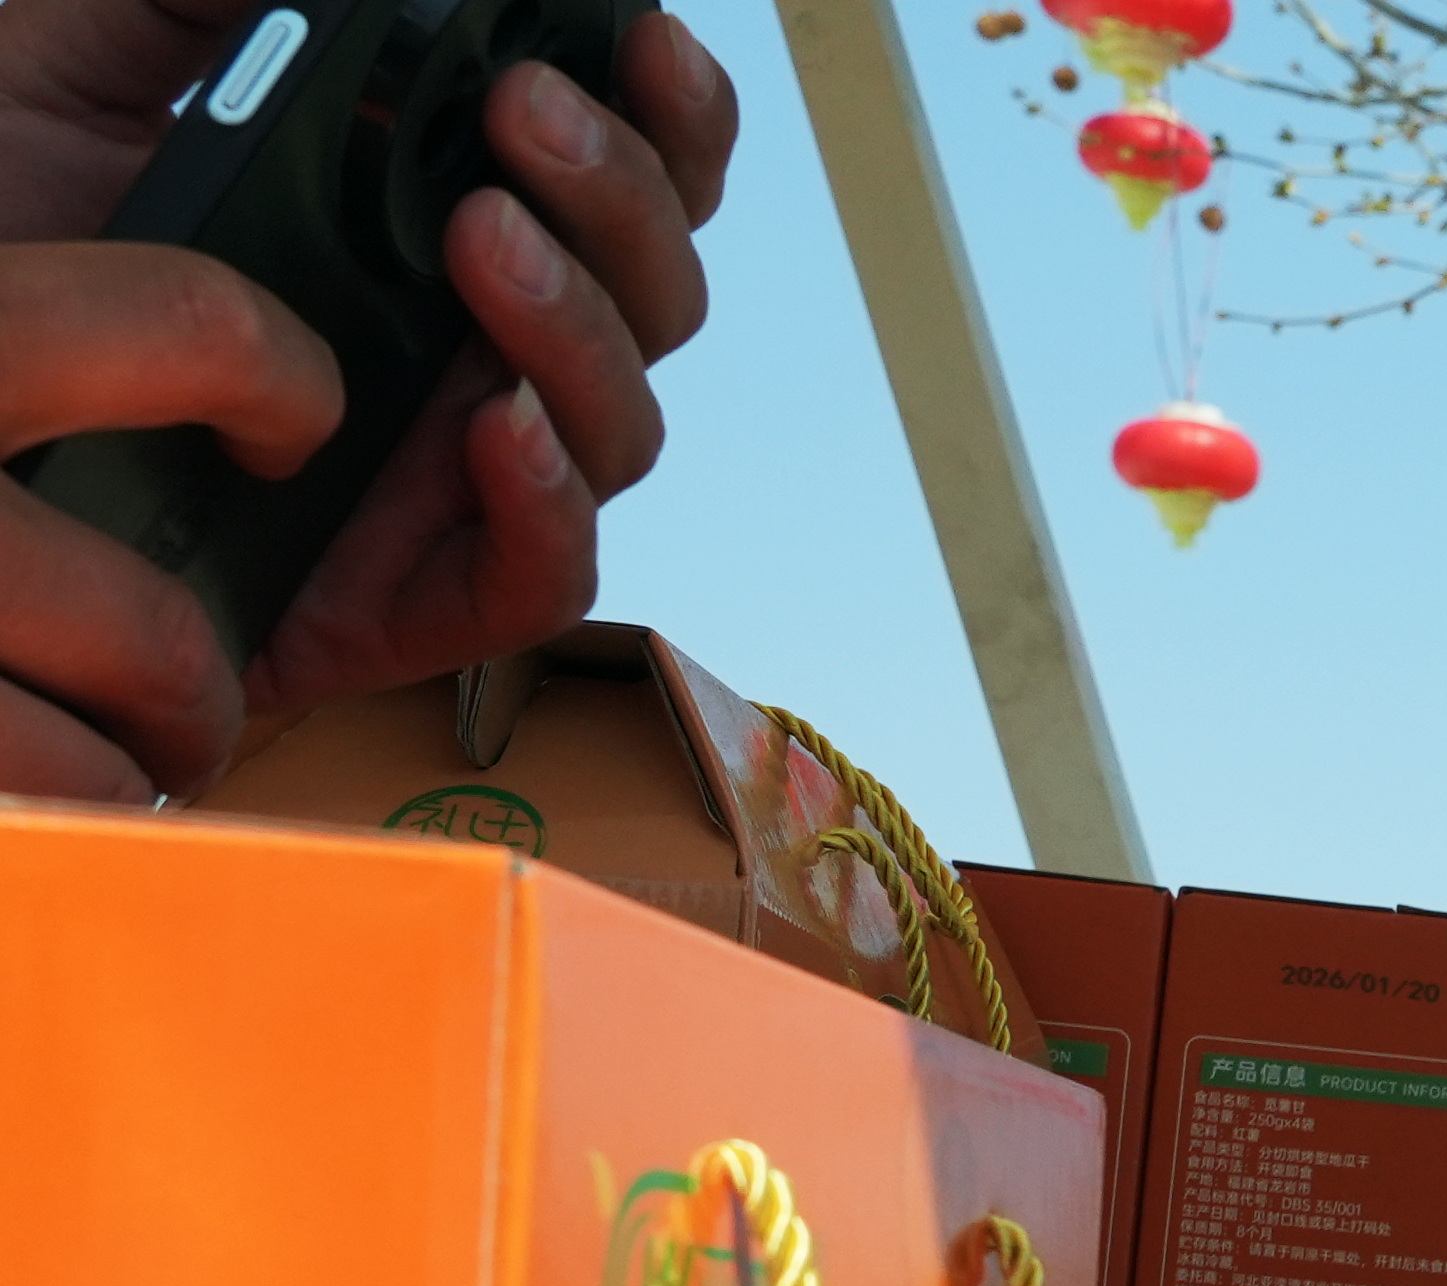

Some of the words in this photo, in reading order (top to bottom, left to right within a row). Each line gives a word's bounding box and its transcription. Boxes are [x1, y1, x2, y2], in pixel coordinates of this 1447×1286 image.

[1281, 964, 1441, 1002] 2026/01/20
[1209, 1057, 1306, 1089] 产品信息
[1320, 1074, 1397, 1096] PRODUCT
